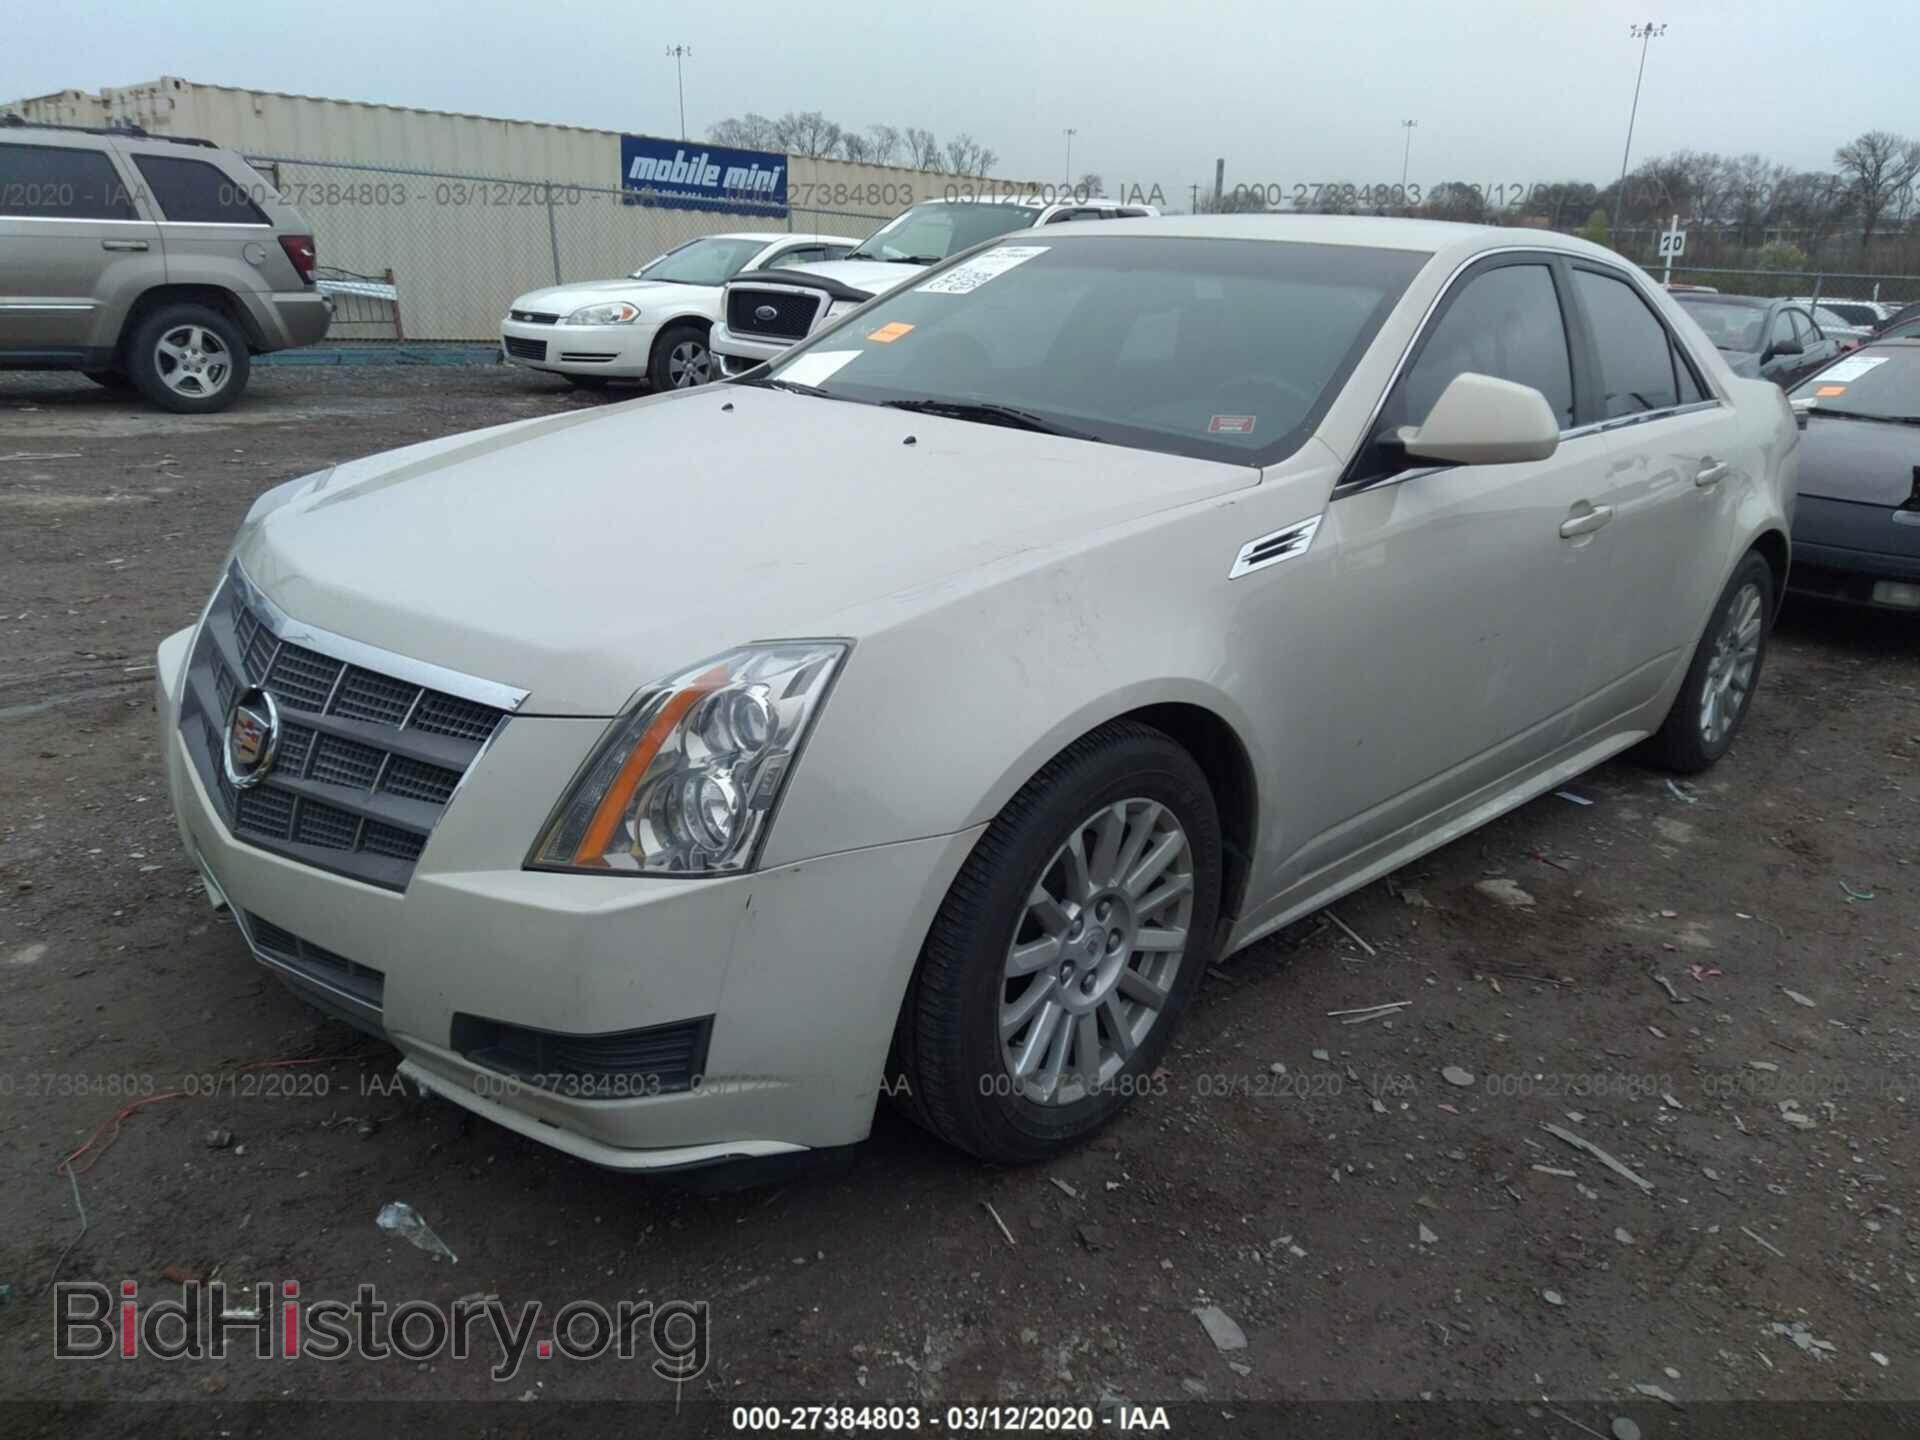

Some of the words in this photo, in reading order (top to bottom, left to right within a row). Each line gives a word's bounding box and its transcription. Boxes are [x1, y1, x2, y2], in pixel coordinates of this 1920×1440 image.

[629, 150, 721, 187] mobile
[723, 163, 780, 193] mini
[1663, 236, 1682, 251] 20
